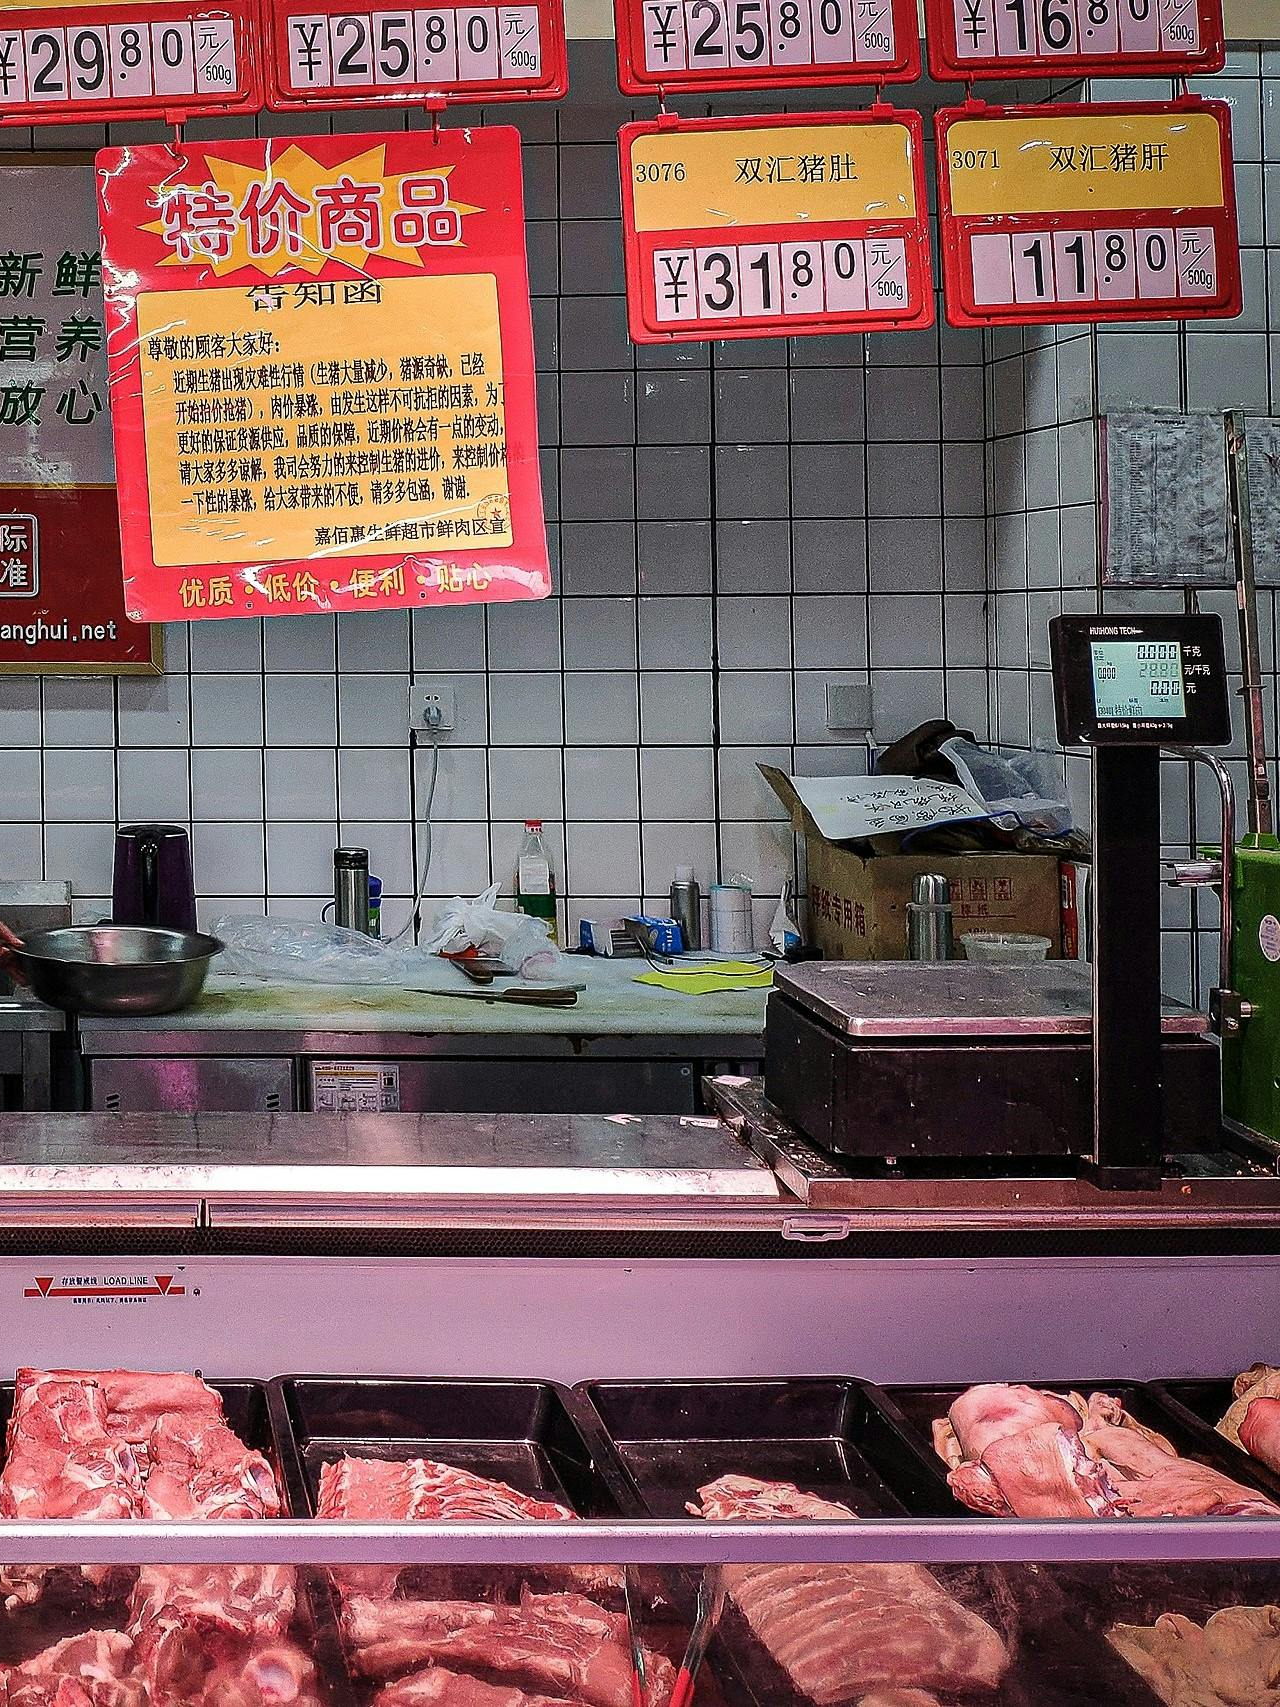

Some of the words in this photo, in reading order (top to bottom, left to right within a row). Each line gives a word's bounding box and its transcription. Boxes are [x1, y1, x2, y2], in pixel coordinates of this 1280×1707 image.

[635, 162, 686, 182] 3076
[734, 153, 859, 184] 双汇猪肚
[952, 149, 1001, 170] 3071
[1049, 142, 1170, 173] 双汇猪肝
[162, 175, 462, 263] 特价商品
[178, 576, 234, 608] 优质
[264, 570, 320, 603] 低价
[349, 565, 406, 597] 便利
[435, 561, 492, 594] 贴心
[103, 1276, 127, 1285] LOAD
[130, 1276, 148, 1285] LINE
